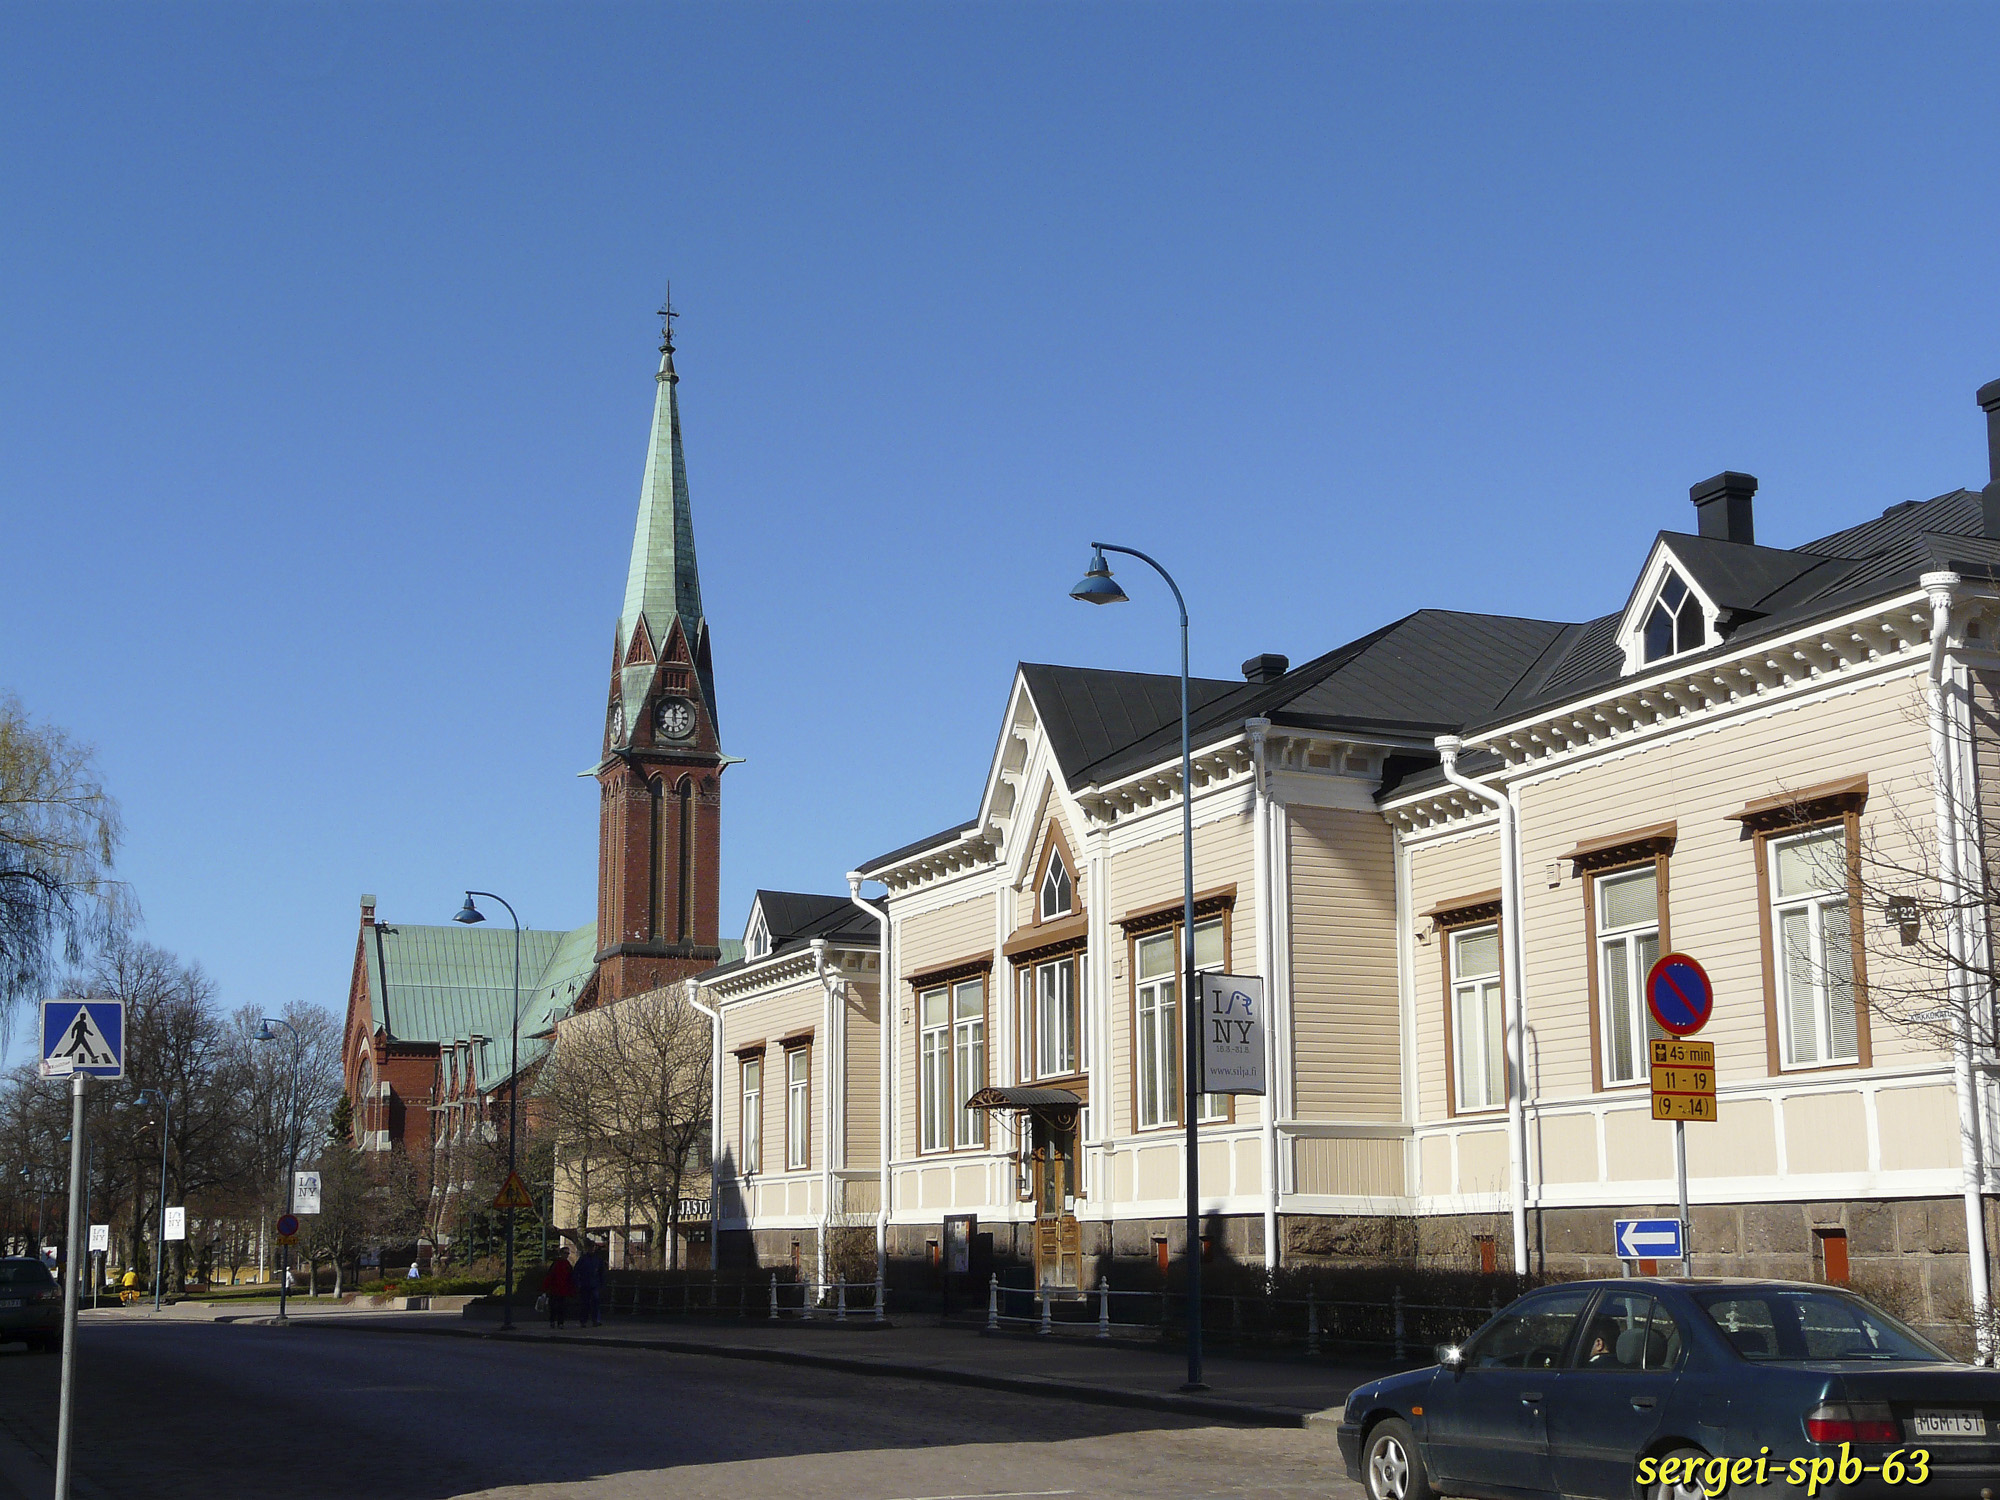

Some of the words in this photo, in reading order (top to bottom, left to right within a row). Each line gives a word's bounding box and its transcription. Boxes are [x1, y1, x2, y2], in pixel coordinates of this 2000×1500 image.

[1211, 989, 1223, 1014] I
[1211, 1018, 1255, 1045] NY
[1669, 1046, 1685, 1061] 45
[1689, 1047, 1711, 1062] min
[1209, 1065, 1257, 1078] www.silja.fi
[1665, 1071, 1676, 1089] 11
[1693, 1072, 1707, 1090] 19
[298, 1187, 317, 1197] NY
